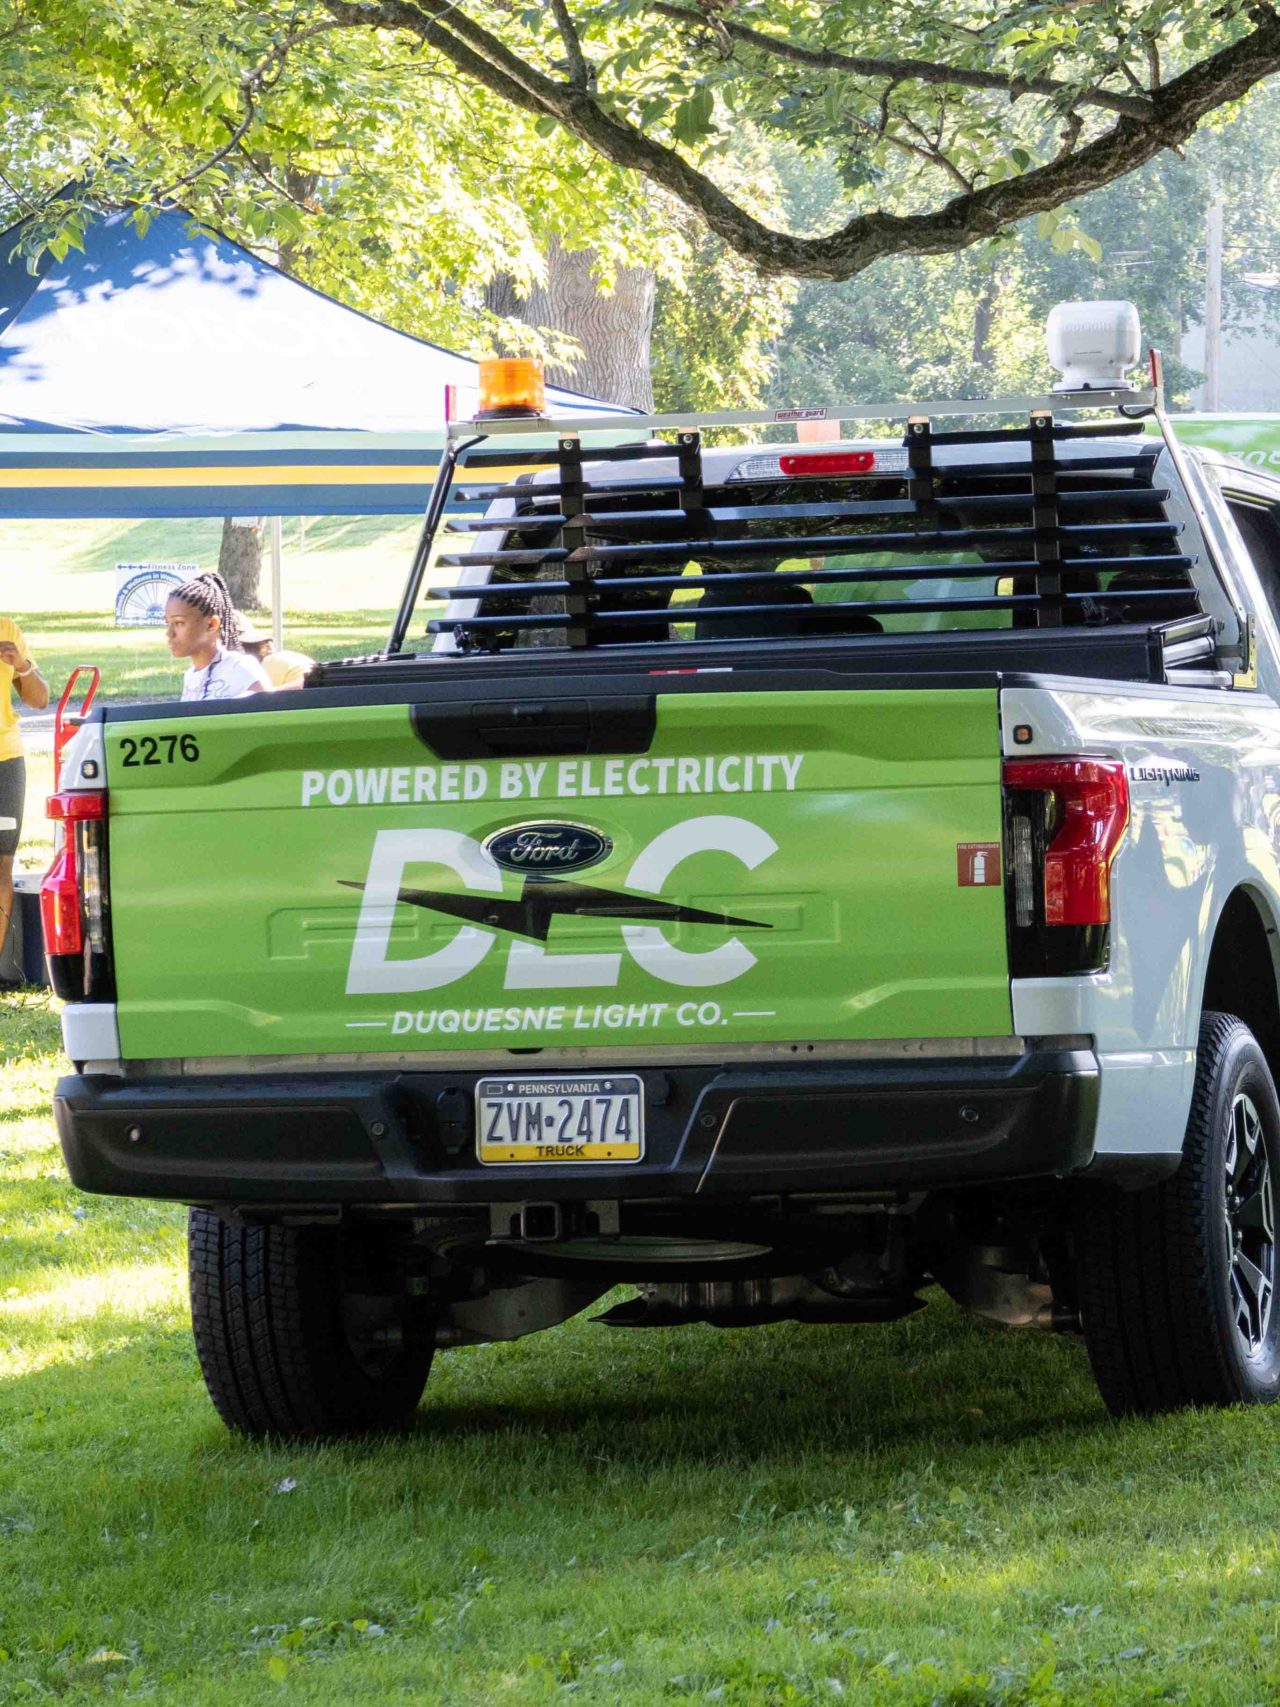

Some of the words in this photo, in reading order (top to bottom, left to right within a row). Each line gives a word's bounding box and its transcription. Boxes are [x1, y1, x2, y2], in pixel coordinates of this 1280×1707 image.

[120, 734, 199, 767] 2276
[302, 765, 488, 807] POWERED
[500, 762, 548, 798] BY
[557, 754, 804, 797] ELECTRICITY
[510, 832, 580, 863] Ford
[345, 815, 780, 995] DLC
[391, 1006, 566, 1034] DUQUESNE
[573, 1003, 669, 1029] LIGHT
[676, 1001, 729, 1026] CO.
[518, 1083, 600, 1094] PENNSYLVANIA
[536, 1145, 585, 1157] TRUCK
